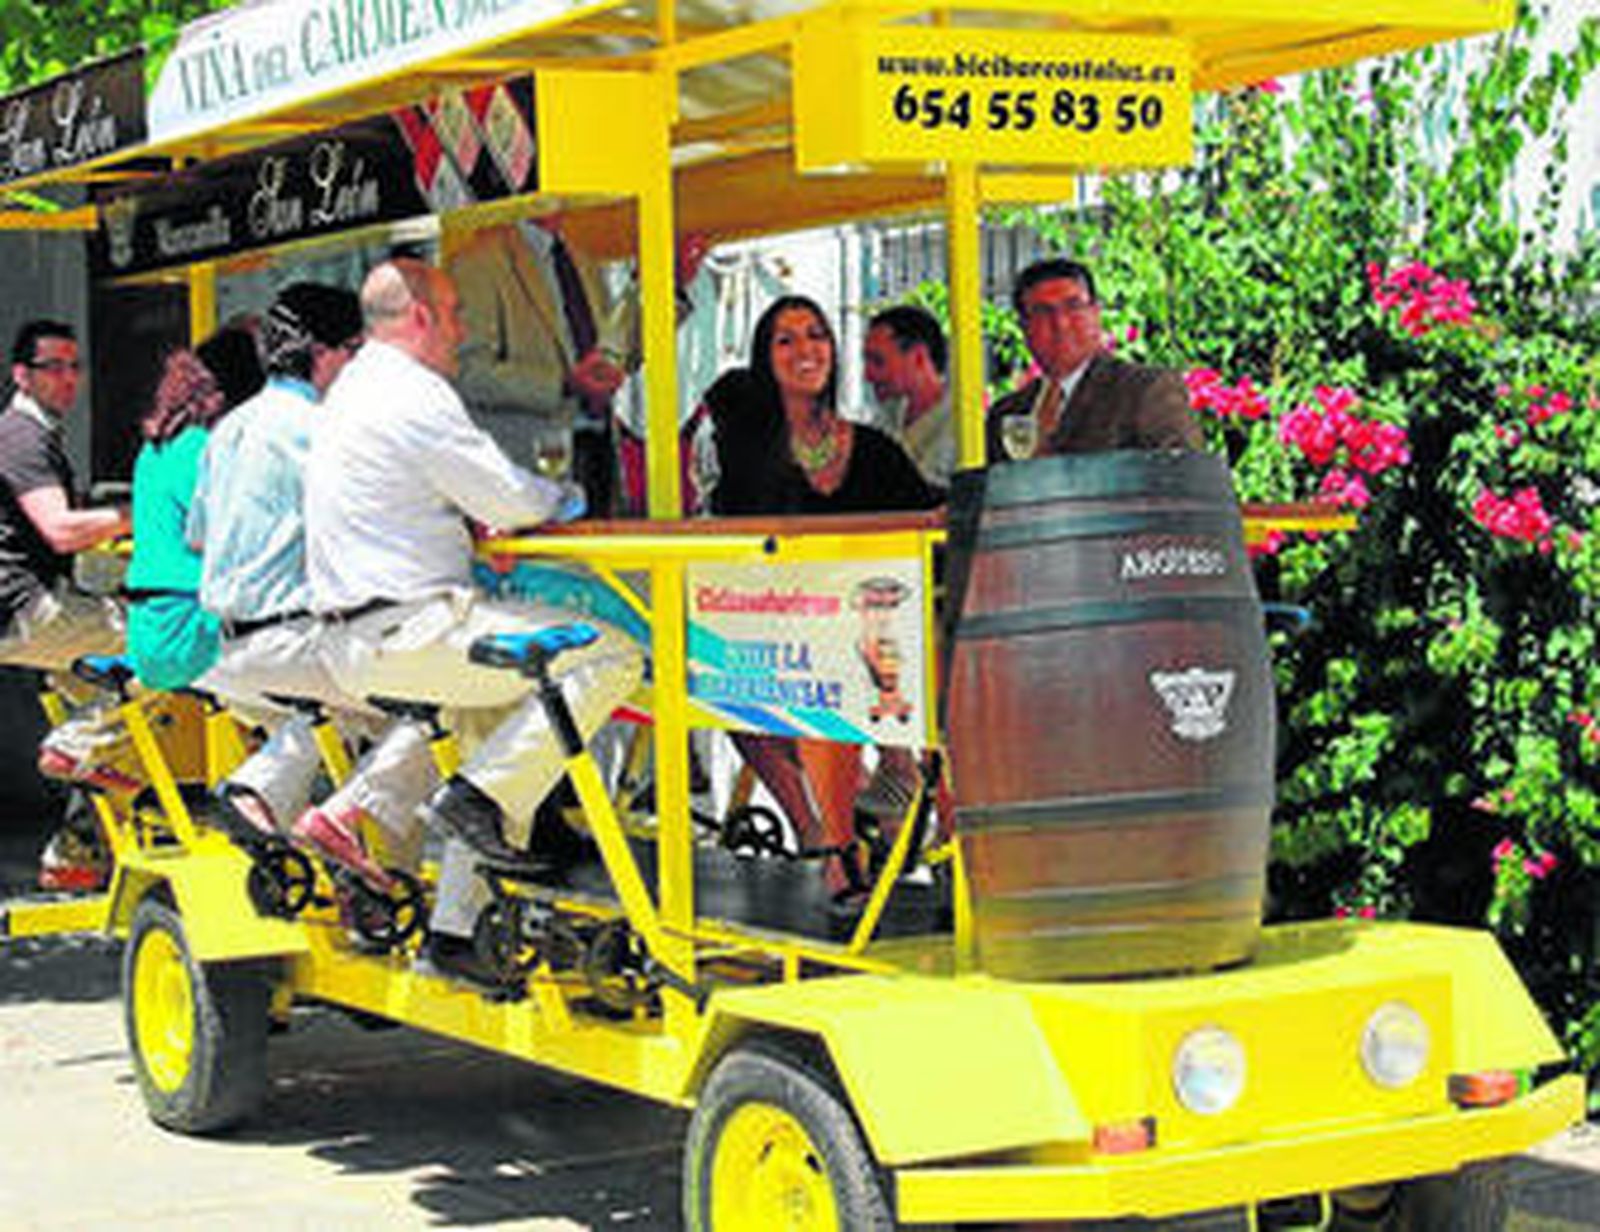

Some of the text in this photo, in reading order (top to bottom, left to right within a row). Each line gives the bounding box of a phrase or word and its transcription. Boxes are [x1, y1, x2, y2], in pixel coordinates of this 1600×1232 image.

[892, 83, 1164, 134] 654 55 83 50
